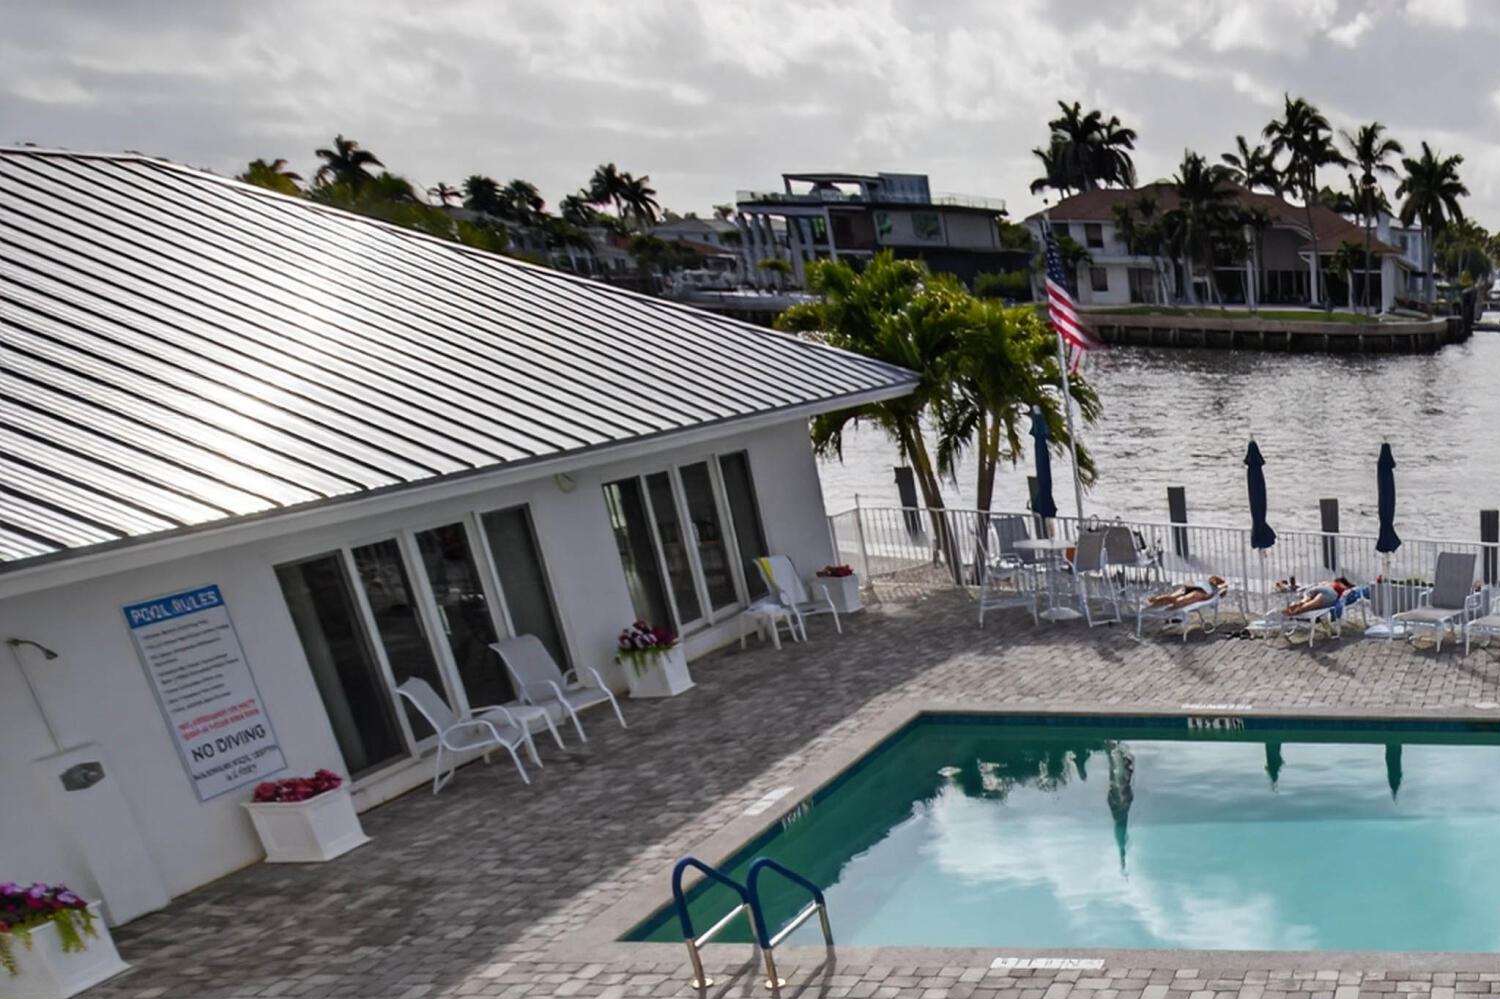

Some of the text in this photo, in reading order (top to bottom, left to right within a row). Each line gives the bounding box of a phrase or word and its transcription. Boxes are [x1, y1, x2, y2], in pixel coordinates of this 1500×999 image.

[130, 590, 219, 622] POOL RULES
[191, 742, 214, 762] NO
[217, 723, 266, 752] DIVING
